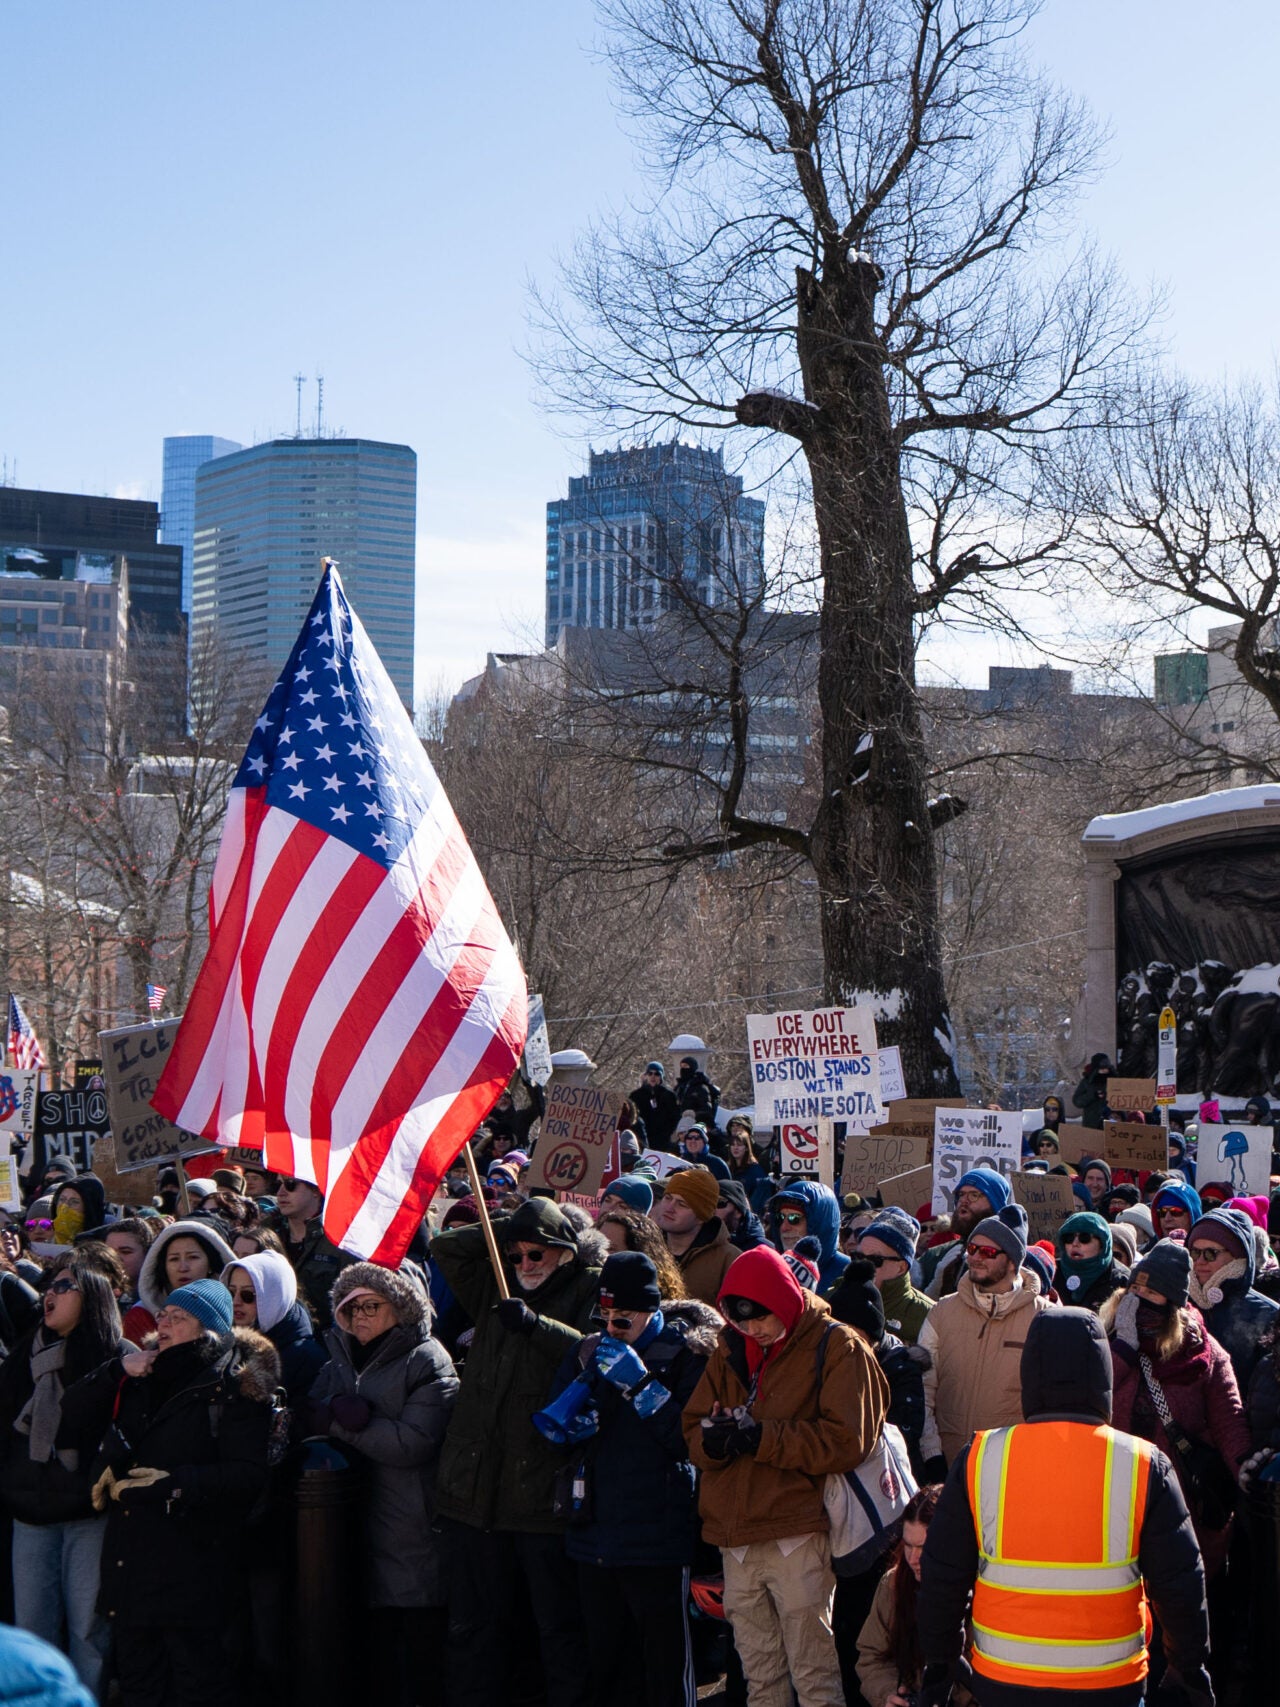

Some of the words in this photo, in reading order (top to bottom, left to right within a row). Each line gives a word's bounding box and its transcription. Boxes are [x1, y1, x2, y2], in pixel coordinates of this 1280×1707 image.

[776, 1014, 803, 1036] ICE
[812, 1011, 845, 1034] OUT
[113, 1029, 170, 1073] ICE
[752, 1034, 862, 1060] EVERYWHERE
[755, 1057, 816, 1084] BOSTON
[824, 1056, 871, 1078] STANDS
[552, 1084, 608, 1111] BOSTON
[804, 1077, 844, 1094] WITH
[774, 1092, 877, 1120] MINNESOTA
[546, 1119, 570, 1138] FOR
[572, 1126, 607, 1146] LESS
[939, 1117, 964, 1128] we
[968, 1115, 1003, 1133] will,
[856, 1138, 914, 1162] STOP
[938, 1134, 964, 1145] we
[552, 1153, 580, 1180] ICE
